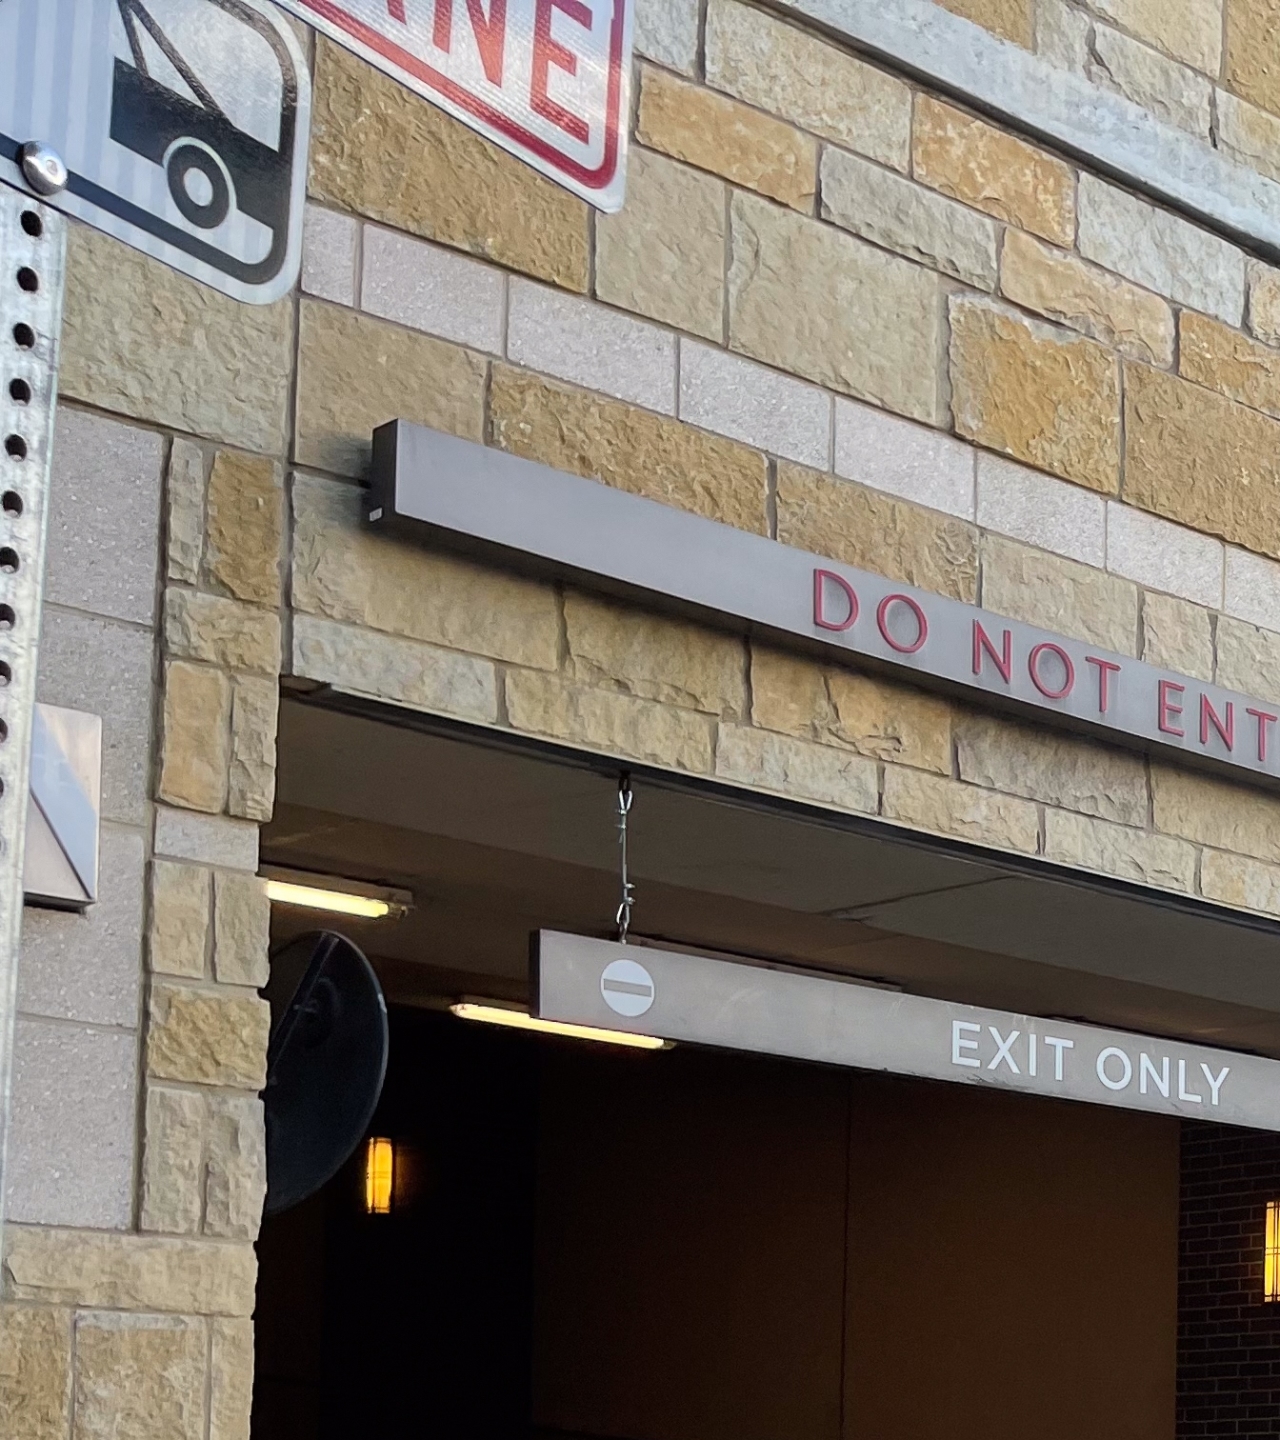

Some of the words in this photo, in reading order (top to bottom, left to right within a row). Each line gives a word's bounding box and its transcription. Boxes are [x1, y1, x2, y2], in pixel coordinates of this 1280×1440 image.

[812, 568, 928, 653] DO
[971, 618, 1121, 713] NOT
[951, 1020, 1075, 1082] EXIT
[1095, 1046, 1230, 1106] ONLY
